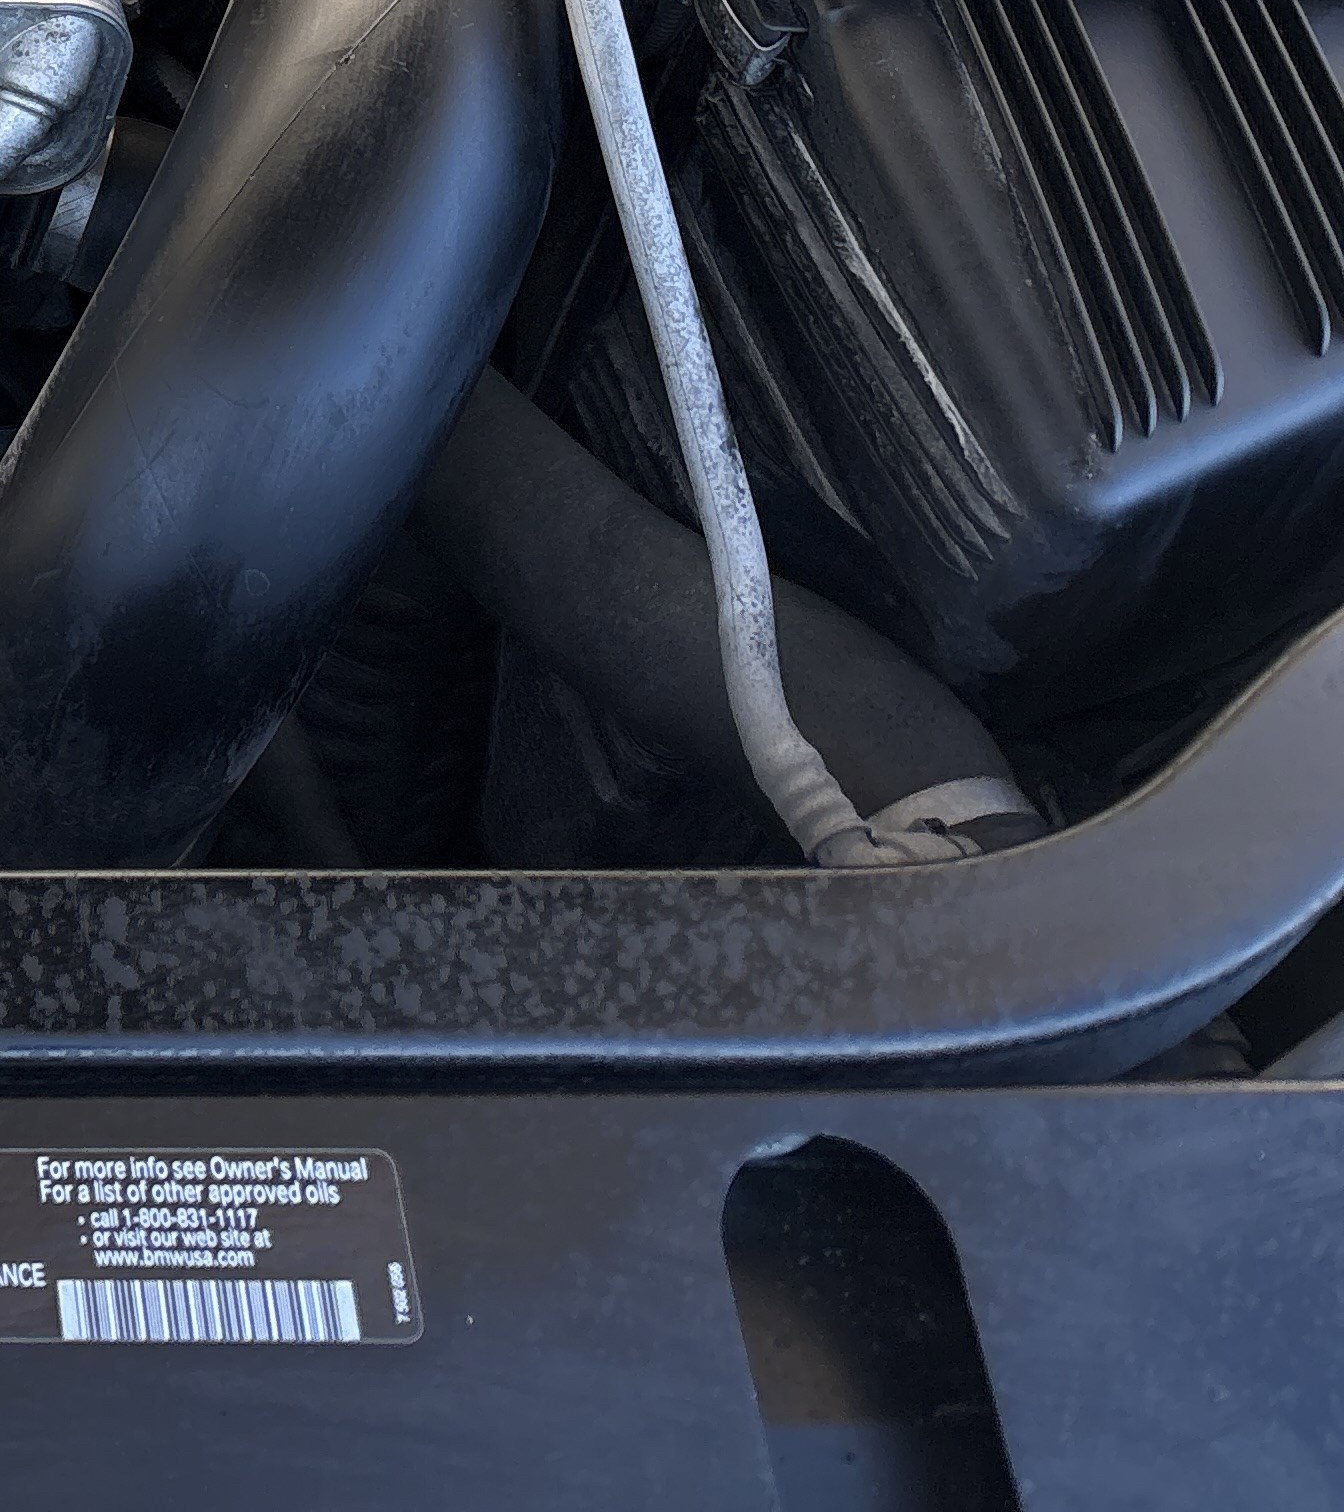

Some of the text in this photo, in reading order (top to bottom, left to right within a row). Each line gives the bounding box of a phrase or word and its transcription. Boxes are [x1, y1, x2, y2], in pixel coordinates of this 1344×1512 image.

[37, 1157, 368, 1181] For more info see Owner's Manual
[40, 1180, 340, 1208] For a list of other approved oils
[90, 1208, 258, 1229] call 1-800-831-1117
[93, 1229, 273, 1248] or visit our web site at
[94, 1248, 255, 1267] www.bmwusa.com
